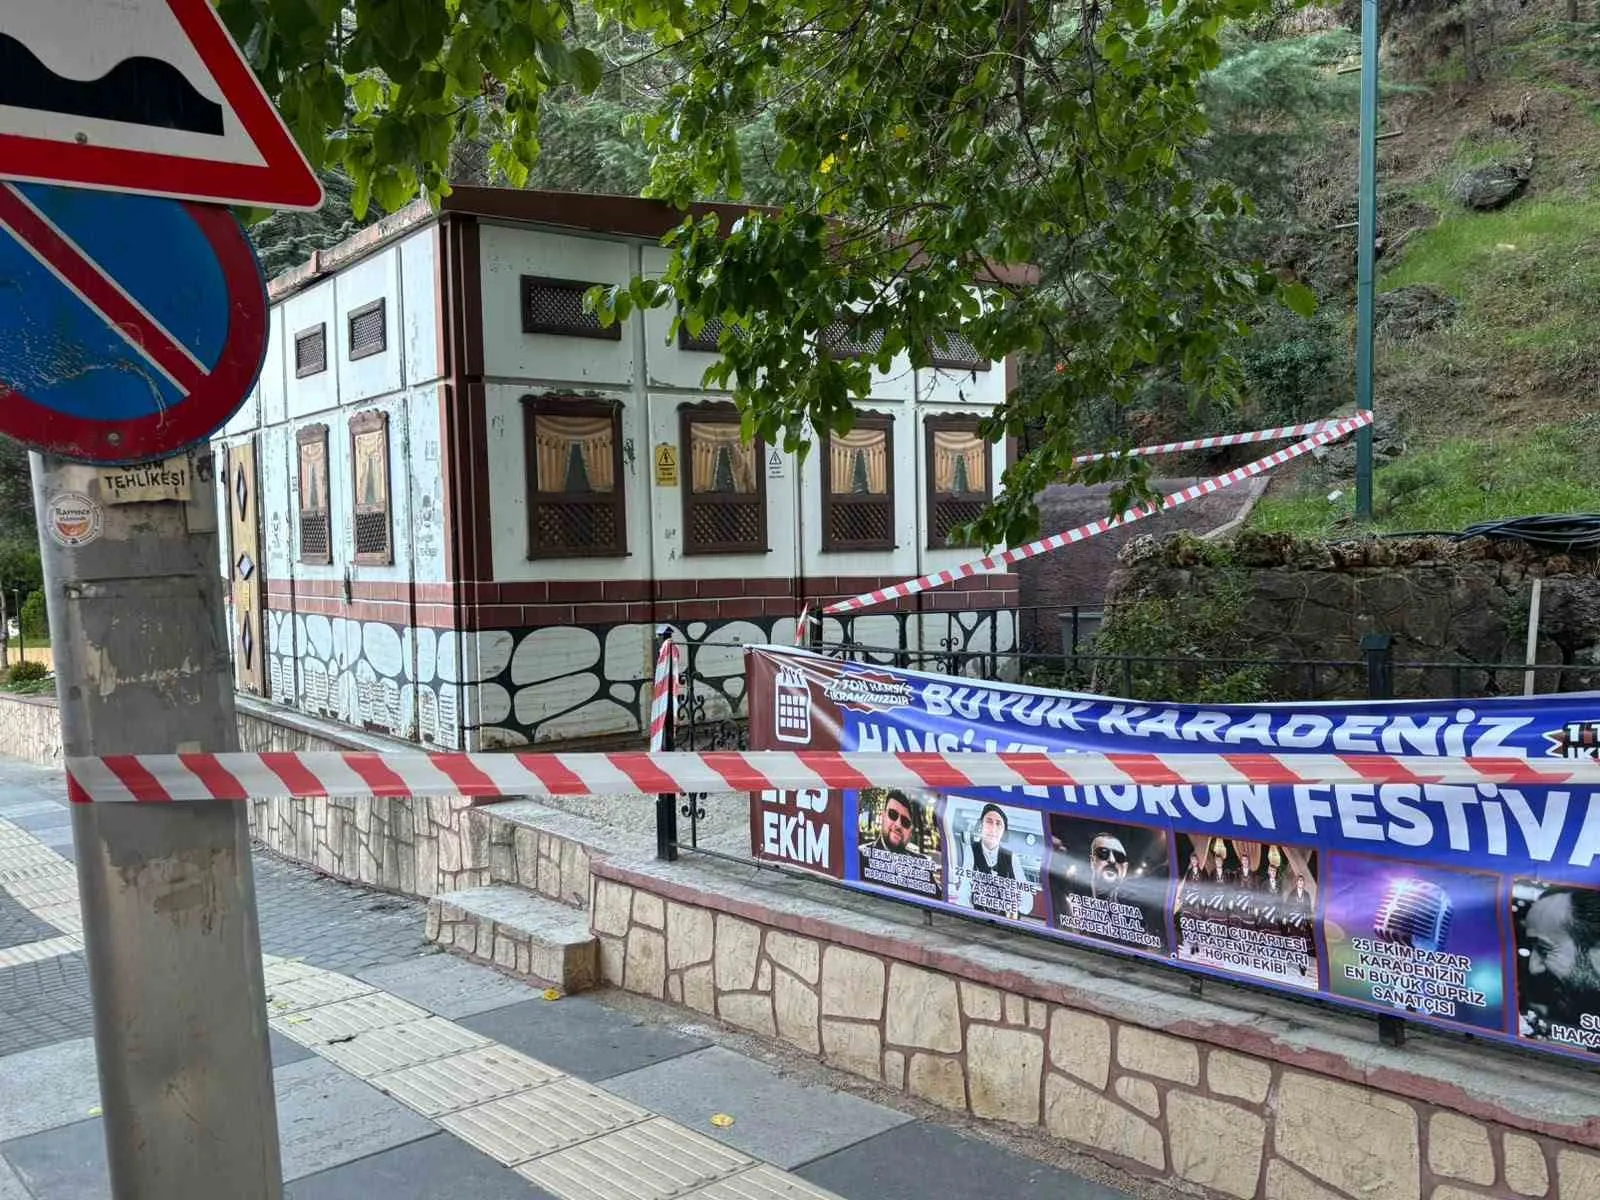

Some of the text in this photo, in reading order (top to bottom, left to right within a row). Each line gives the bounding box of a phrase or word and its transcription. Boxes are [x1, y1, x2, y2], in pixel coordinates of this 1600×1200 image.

[1098, 704, 1536, 758] KARADENİZ
[763, 811, 830, 869] EKİM
[955, 866, 965, 876] 22
[1109, 902, 1144, 920] CUMA
[1119, 930, 1162, 948] HORON
[1181, 917, 1195, 930] 24
[1196, 920, 1228, 937] EKİM
[1182, 931, 1309, 966] KARADENİZ KIZLARI
[1205, 948, 1250, 966] HORON
[1353, 938, 1471, 971] 25 EKİM PAZAR
[1344, 966, 1365, 980] EN
[1359, 954, 1465, 985] KARADENİZİN
[1373, 987, 1456, 1016] SANATÇISI
